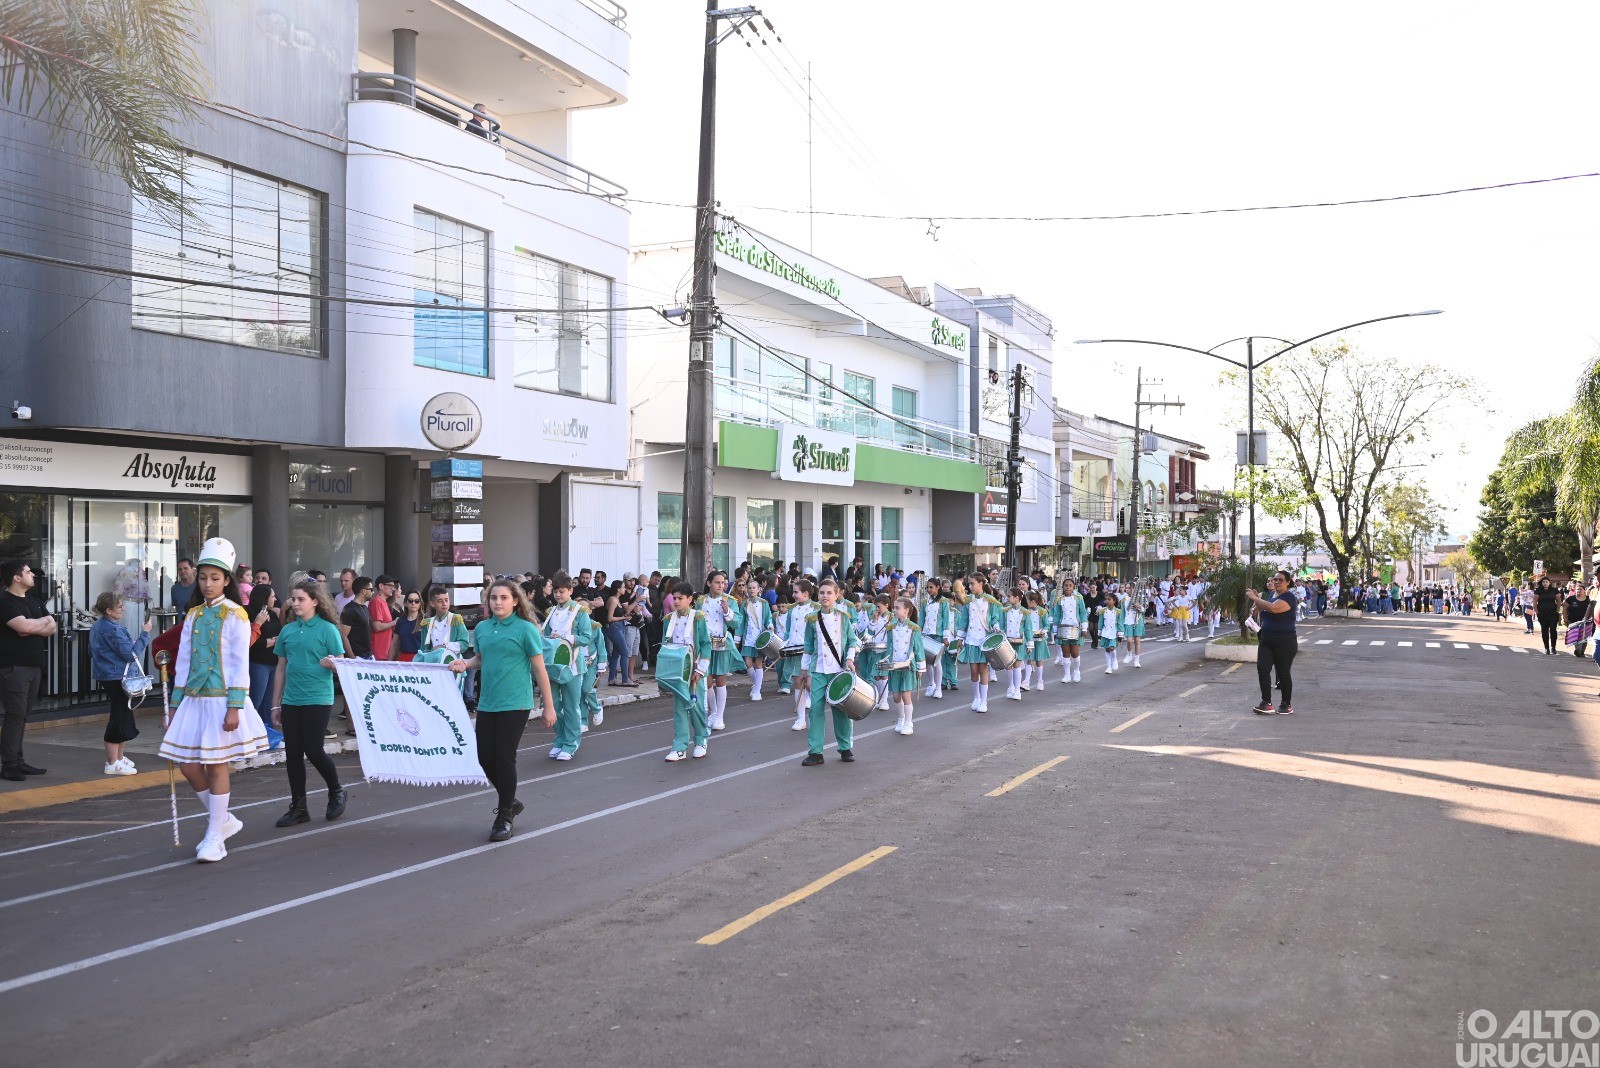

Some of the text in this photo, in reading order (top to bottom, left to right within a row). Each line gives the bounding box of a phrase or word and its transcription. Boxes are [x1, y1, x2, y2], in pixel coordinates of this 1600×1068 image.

[715, 230, 747, 261] Sede
[764, 251, 803, 285] Sicredi
[427, 415, 473, 432] Plurall
[542, 418, 589, 439] SHADOW
[808, 442, 850, 472] Sicredi
[185, 482, 215, 490] concept
[308, 473, 352, 494] Plurall
[357, 673, 431, 684] BANDA MARCIAL
[380, 682, 399, 694] JOSÉ
[401, 686, 431, 705] ANDRÉ
[380, 744, 463, 757] RODEIO BONITO RS
